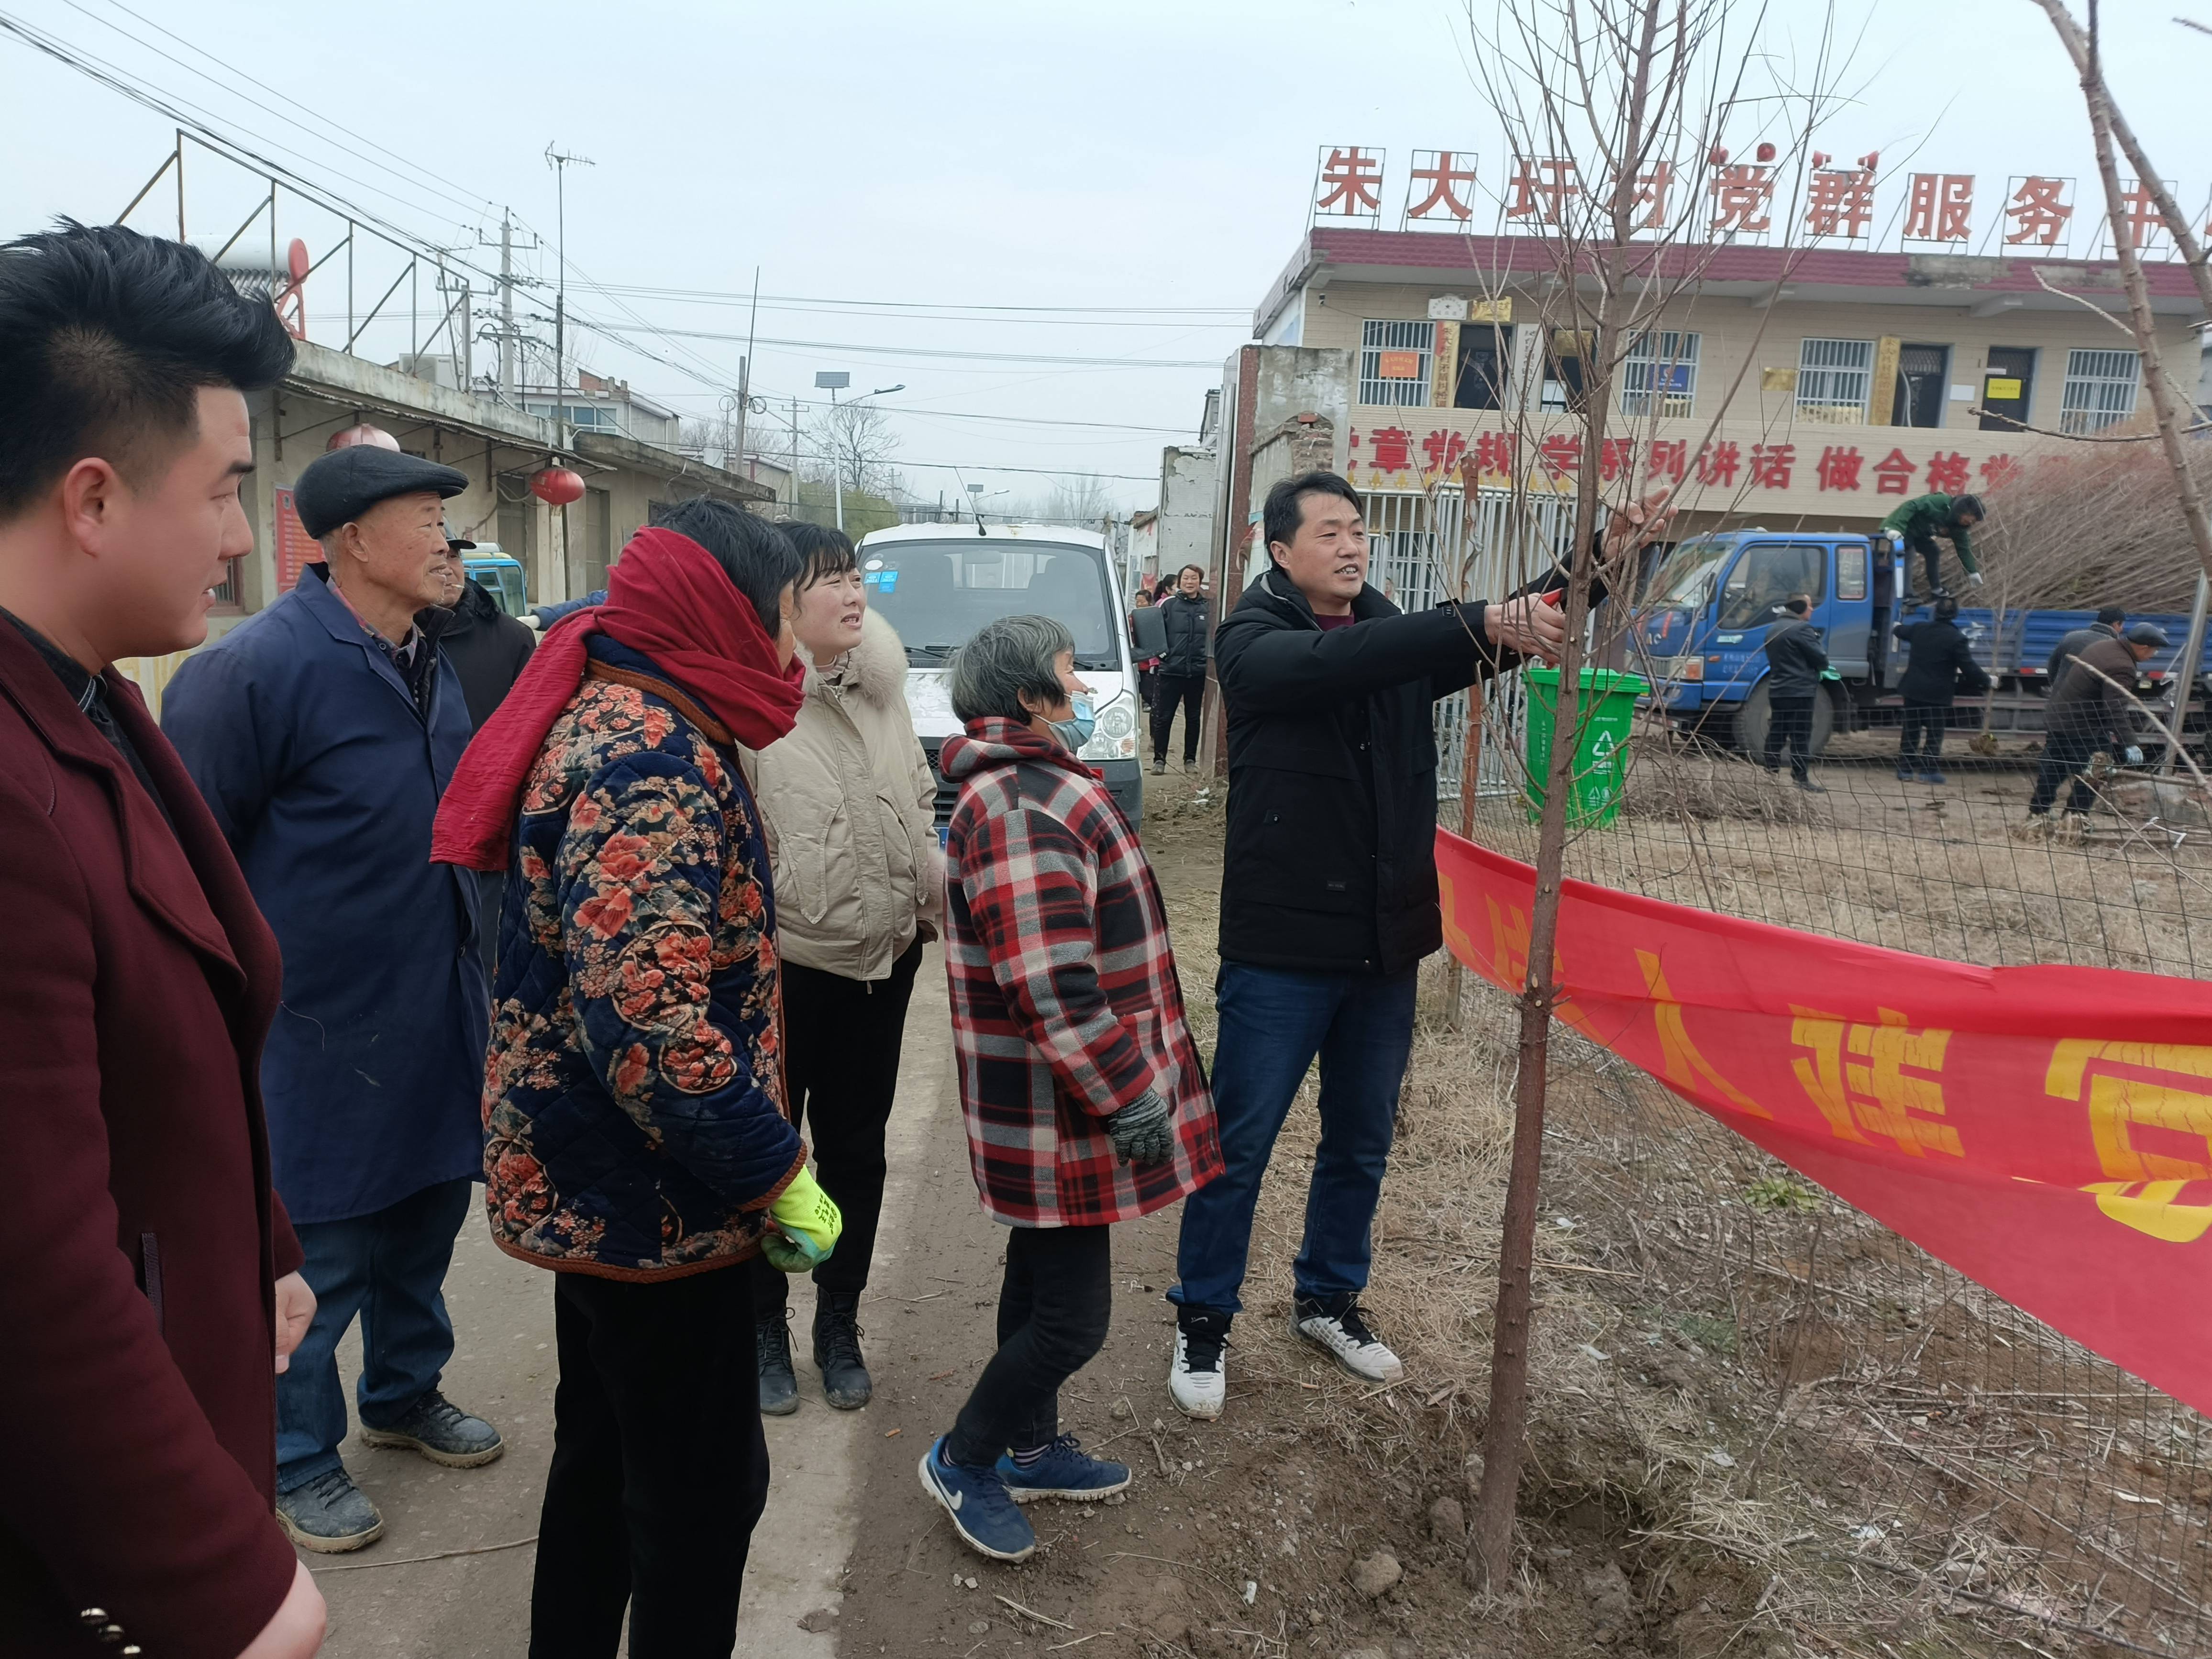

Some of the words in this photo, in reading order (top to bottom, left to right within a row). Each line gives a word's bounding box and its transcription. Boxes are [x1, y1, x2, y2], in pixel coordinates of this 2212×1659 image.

[1317, 145, 2212, 248] 朱大圩村党群服务中
[1348, 425, 1517, 477] 章党规
[1815, 445, 2071, 500] 做合格党
